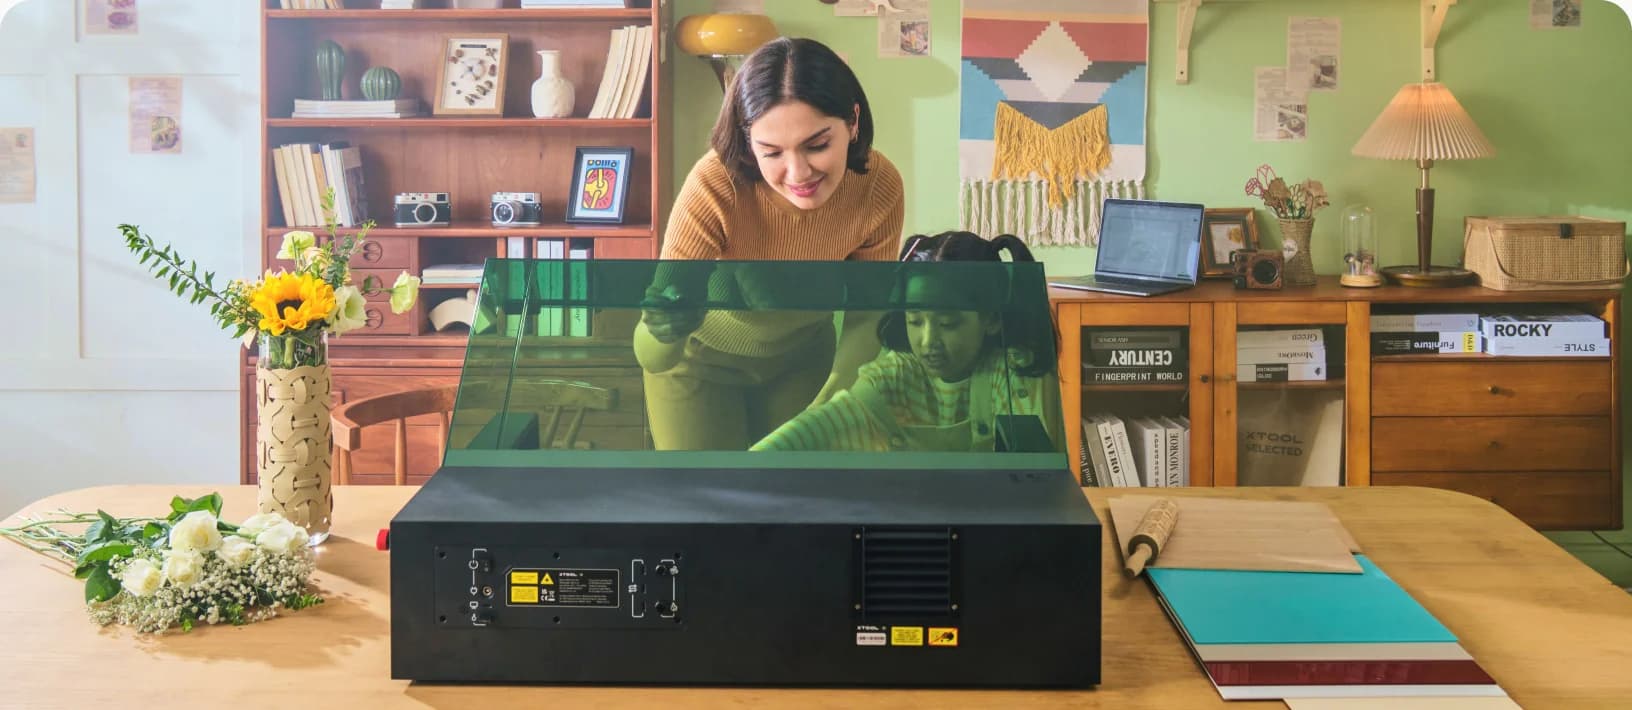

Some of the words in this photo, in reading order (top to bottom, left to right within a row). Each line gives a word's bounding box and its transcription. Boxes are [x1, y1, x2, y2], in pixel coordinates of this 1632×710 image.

[1494, 324, 1553, 337] ROCKY
[1413, 340, 1455, 350] Furniture
[1564, 343, 1596, 352] STYLE
[1108, 350, 1173, 366] CENTURY
[1095, 372, 1152, 381] FINGERPRINT
[1156, 372, 1183, 381] WORLD
[1169, 431, 1180, 472] MONROE
[1246, 443, 1303, 457] SELECTED
